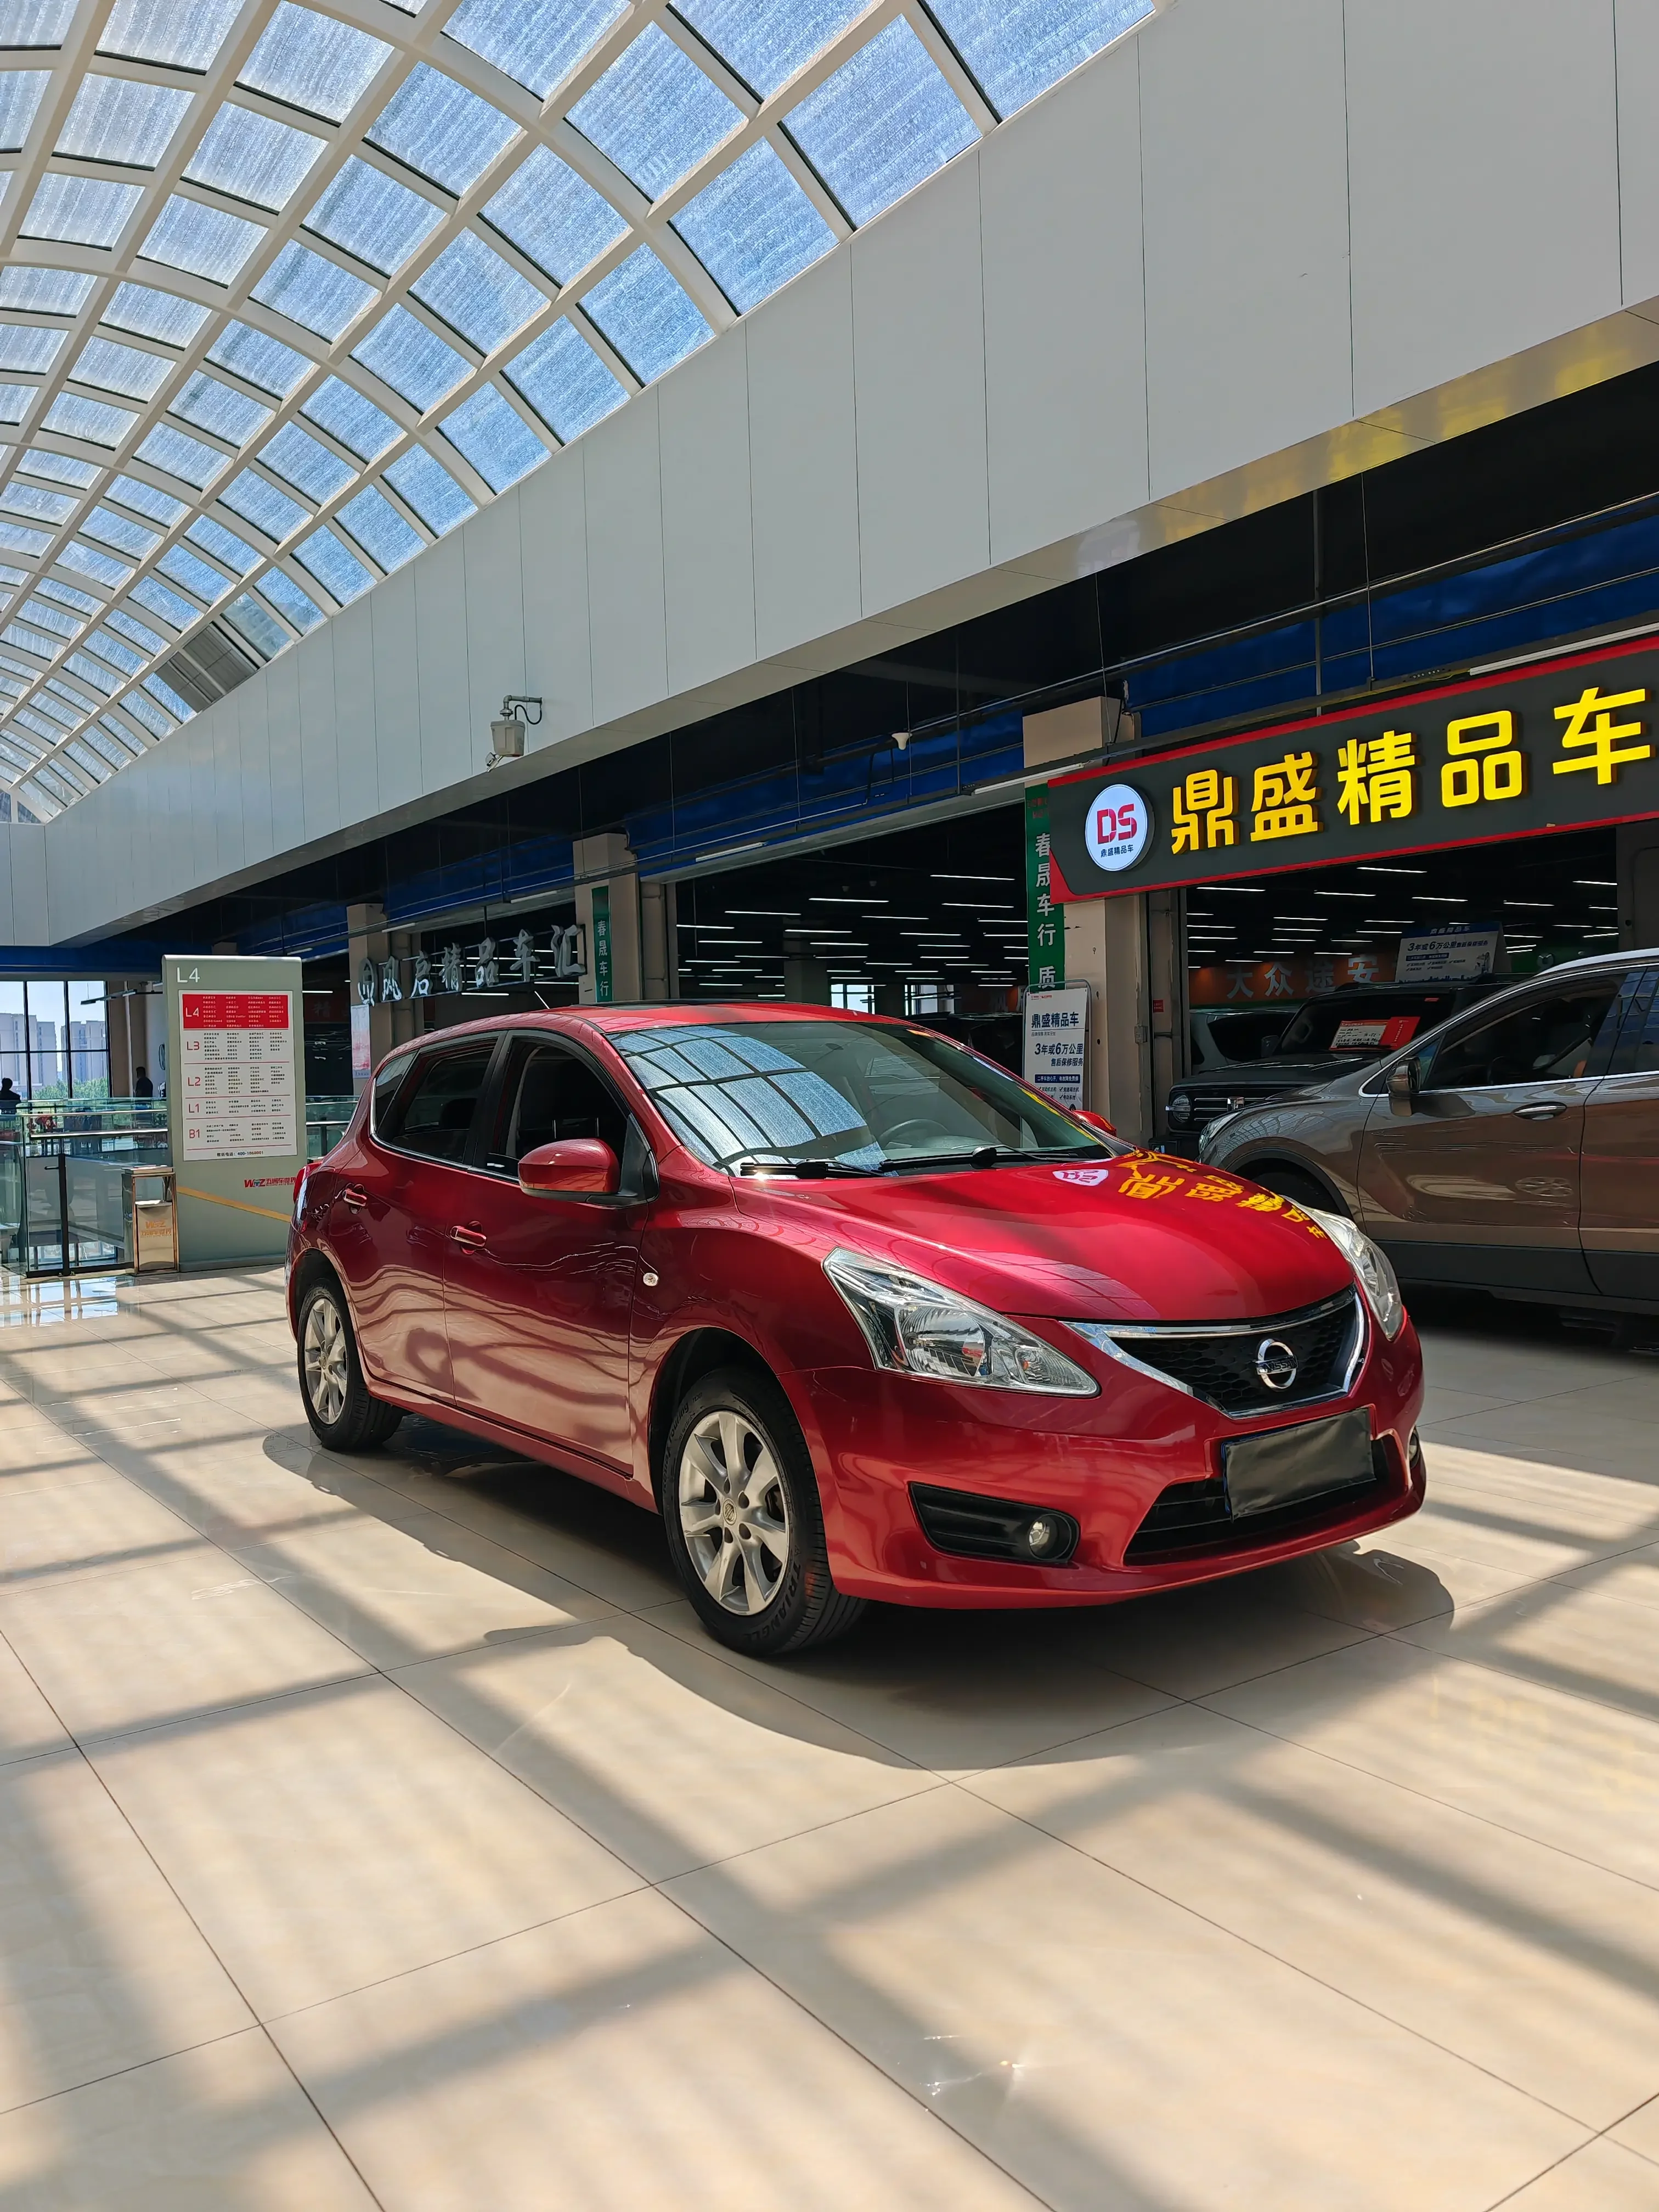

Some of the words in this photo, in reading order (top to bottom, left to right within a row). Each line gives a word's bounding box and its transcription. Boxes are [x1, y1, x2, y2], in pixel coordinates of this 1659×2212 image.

[1171, 687, 1651, 854] 鼎盛精品车
[1097, 803, 1137, 844] DS
[1101, 844, 1134, 857] 鼎盛精品车
[597, 919, 609, 997] 春晟车行
[177, 967, 200, 983] L4
[185, 1007, 199, 1017] L4
[1031, 1011, 1079, 1029] 鼎盛精品车
[187, 1041, 200, 1051] L3
[1034, 1042, 1083, 1056] 3年或6万公里
[1051, 1057, 1083, 1066] 售后保修服务
[188, 1076, 201, 1086] L2
[188, 1103, 199, 1113] L1
[189, 1128, 200, 1139] B1
